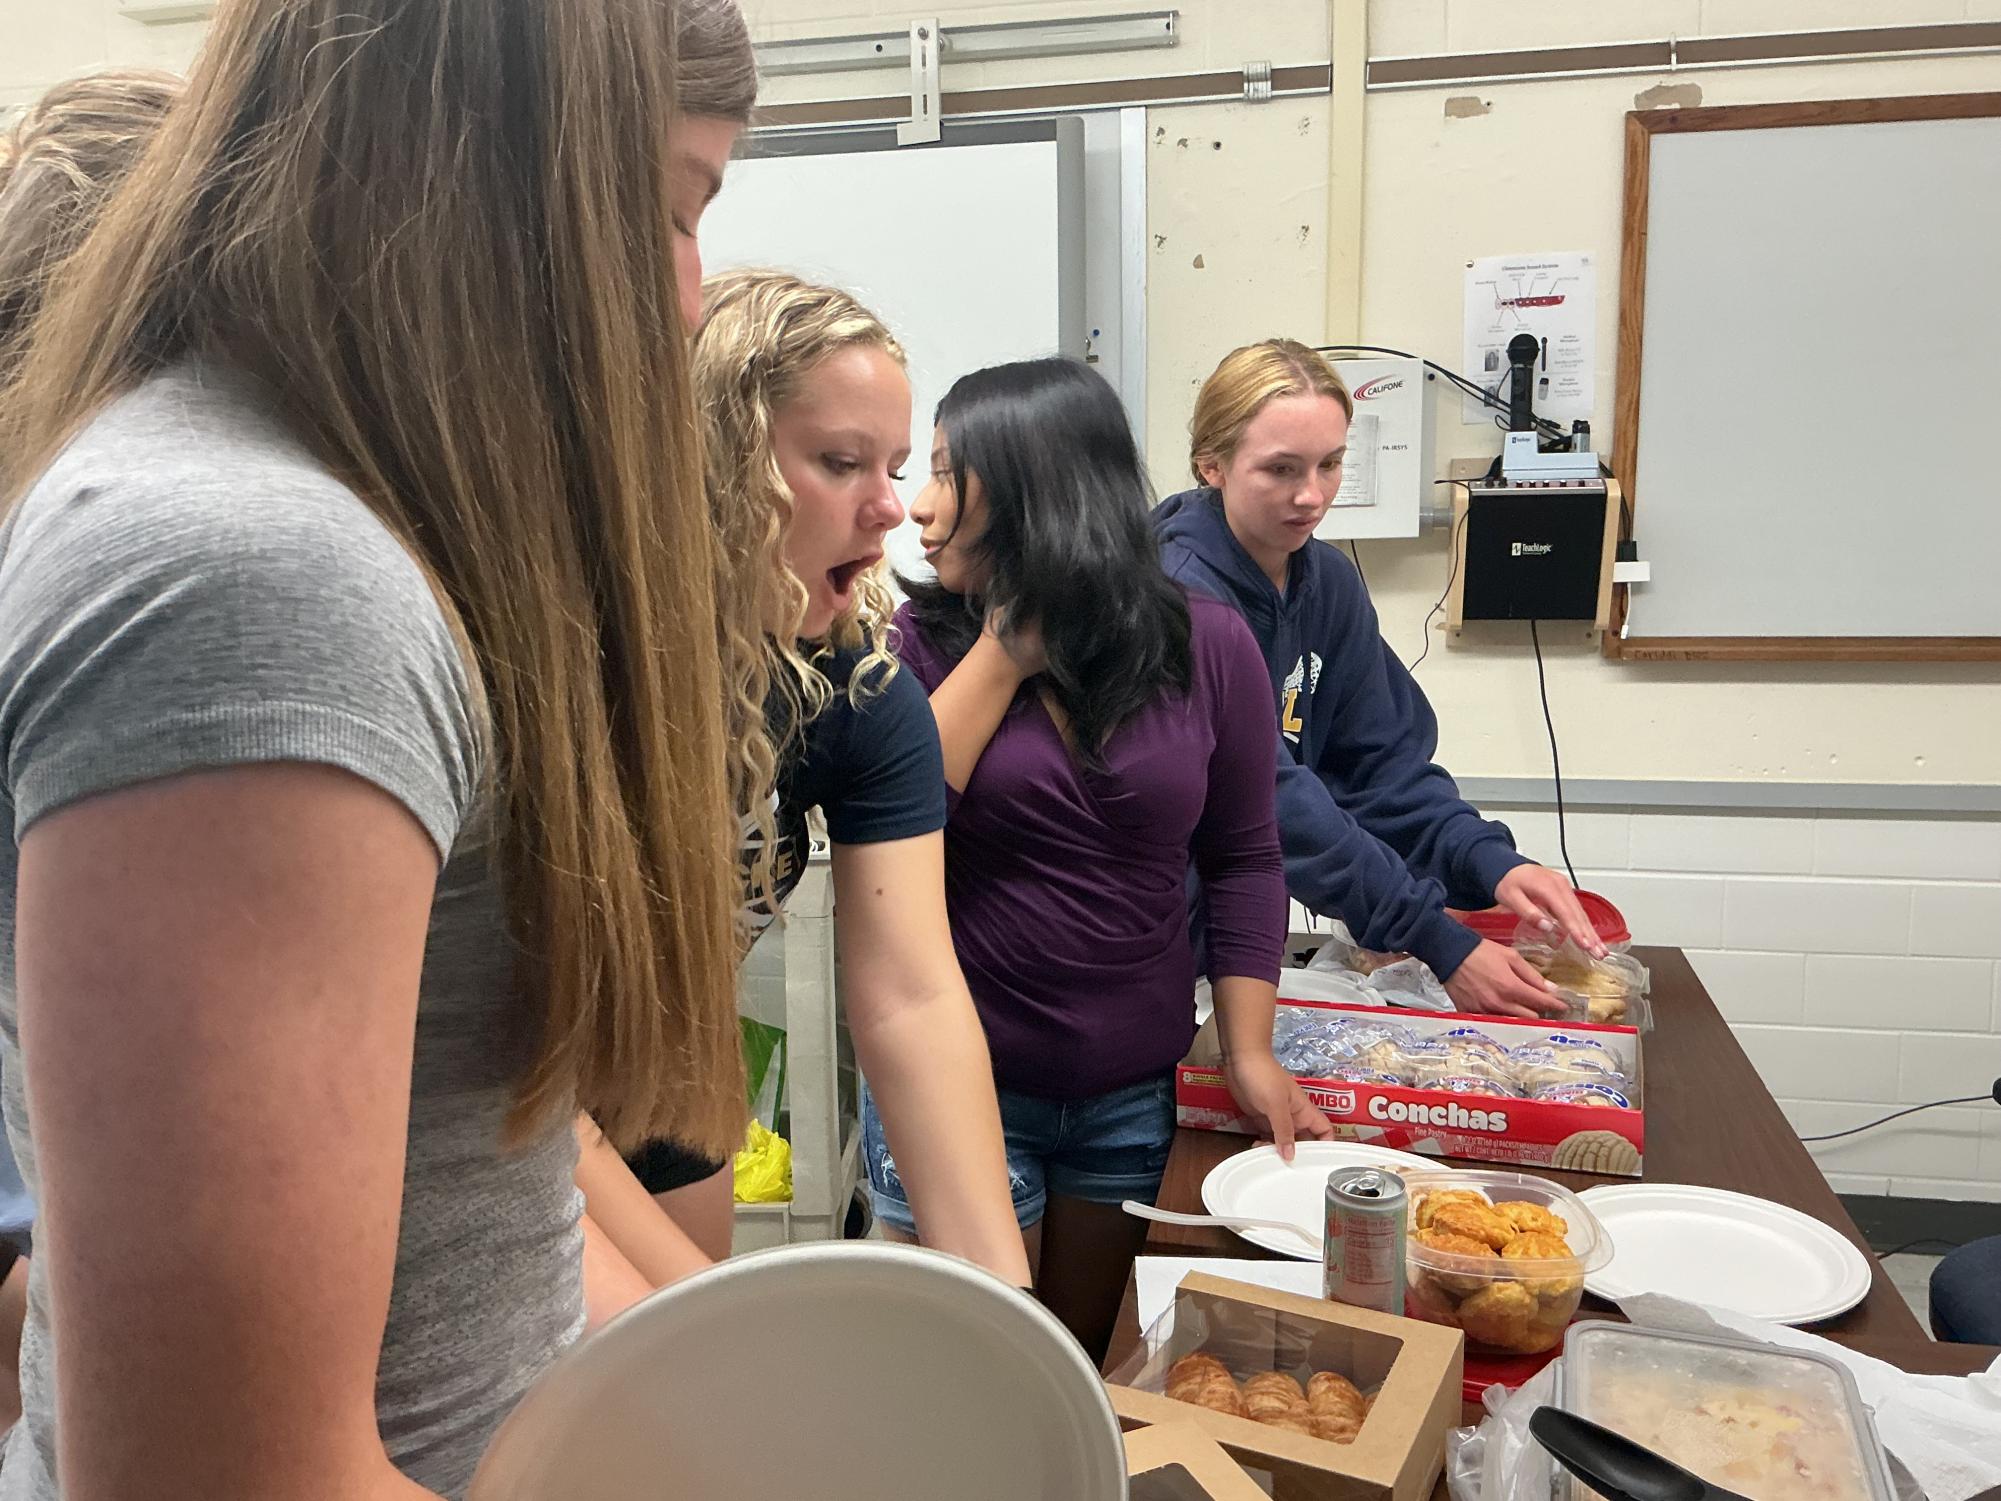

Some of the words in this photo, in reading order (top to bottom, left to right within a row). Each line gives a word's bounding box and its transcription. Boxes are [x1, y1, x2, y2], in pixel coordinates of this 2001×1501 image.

[1367, 380, 1404, 396] CALIFONE
[1182, 1071, 1192, 1083] 8
[1308, 1091, 1351, 1109] MBO
[1368, 1095, 1508, 1132] Conchas
[1414, 1126, 1427, 1137] Fine
[1428, 1128, 1447, 1139] Pastry
